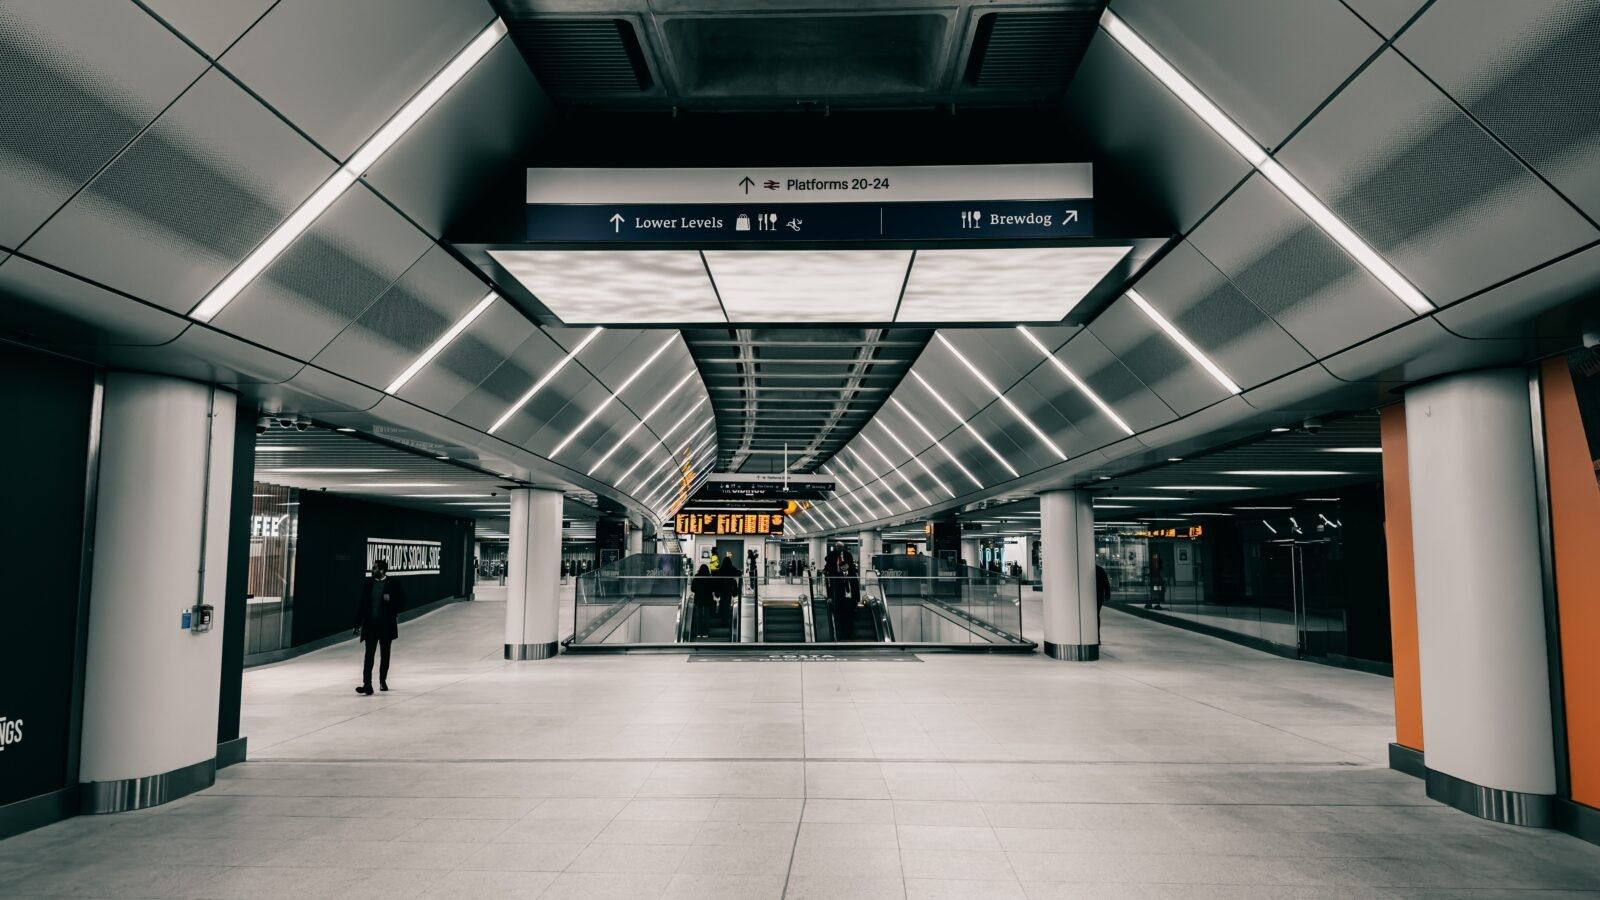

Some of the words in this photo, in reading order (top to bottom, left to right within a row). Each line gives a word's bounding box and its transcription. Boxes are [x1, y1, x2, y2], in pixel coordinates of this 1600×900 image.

[787, 178, 849, 191] Platforms
[851, 177, 890, 190] 20-24
[635, 216, 678, 229] Lower
[680, 216, 723, 229] Levels
[990, 212, 1052, 227] Brewdog
[251, 515, 280, 537] FEE
[408, 545, 428, 570] SOCIAL
[429, 546, 441, 569] SIDE
